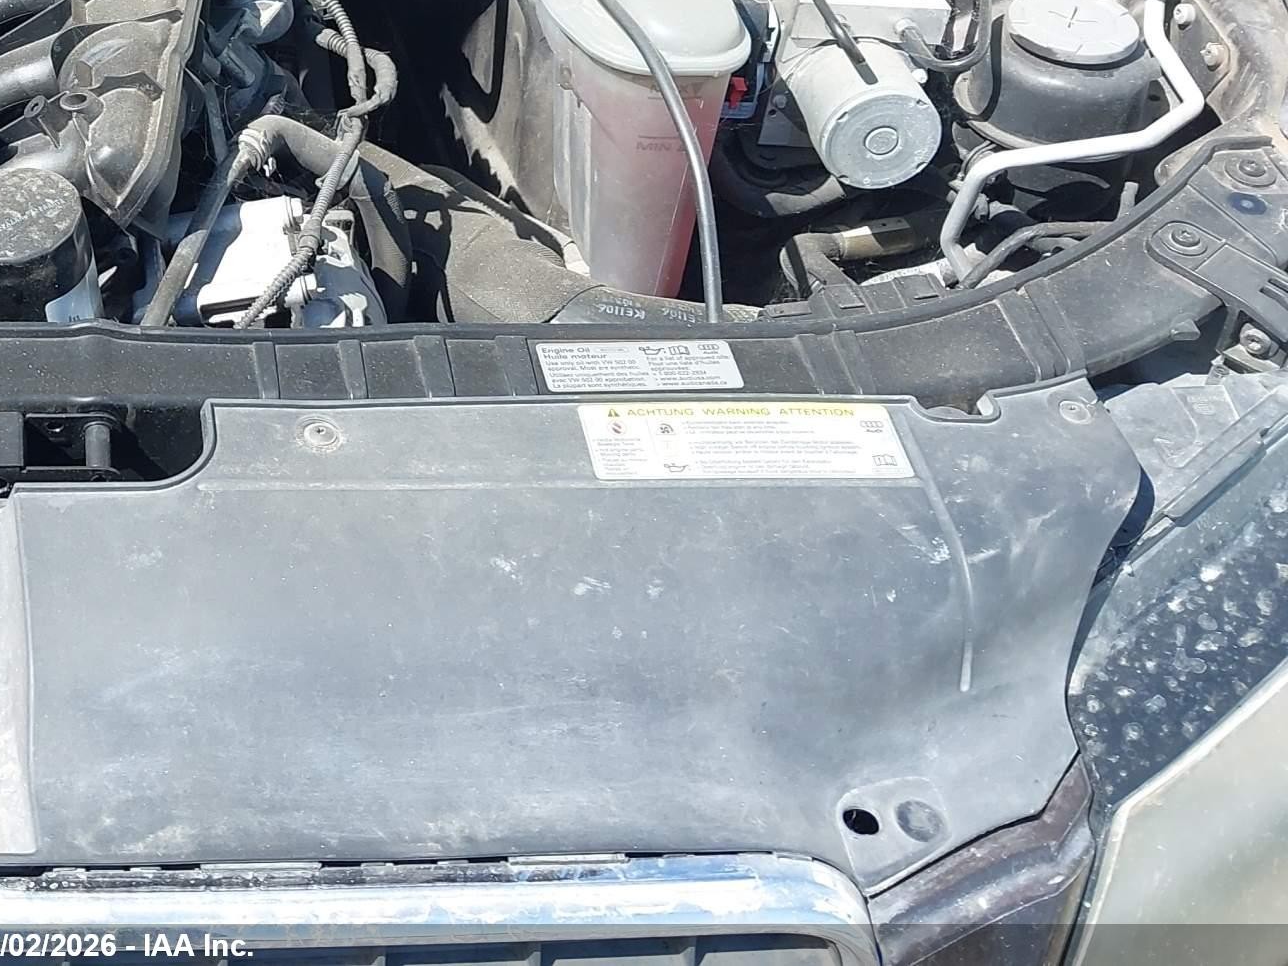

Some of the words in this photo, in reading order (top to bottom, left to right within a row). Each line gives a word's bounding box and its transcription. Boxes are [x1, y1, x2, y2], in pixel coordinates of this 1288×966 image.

[542, 347, 574, 355] Engine
[627, 407, 693, 417] ACHTUNG
[702, 407, 771, 417] WARNING
[779, 407, 854, 418] ATTENTION
